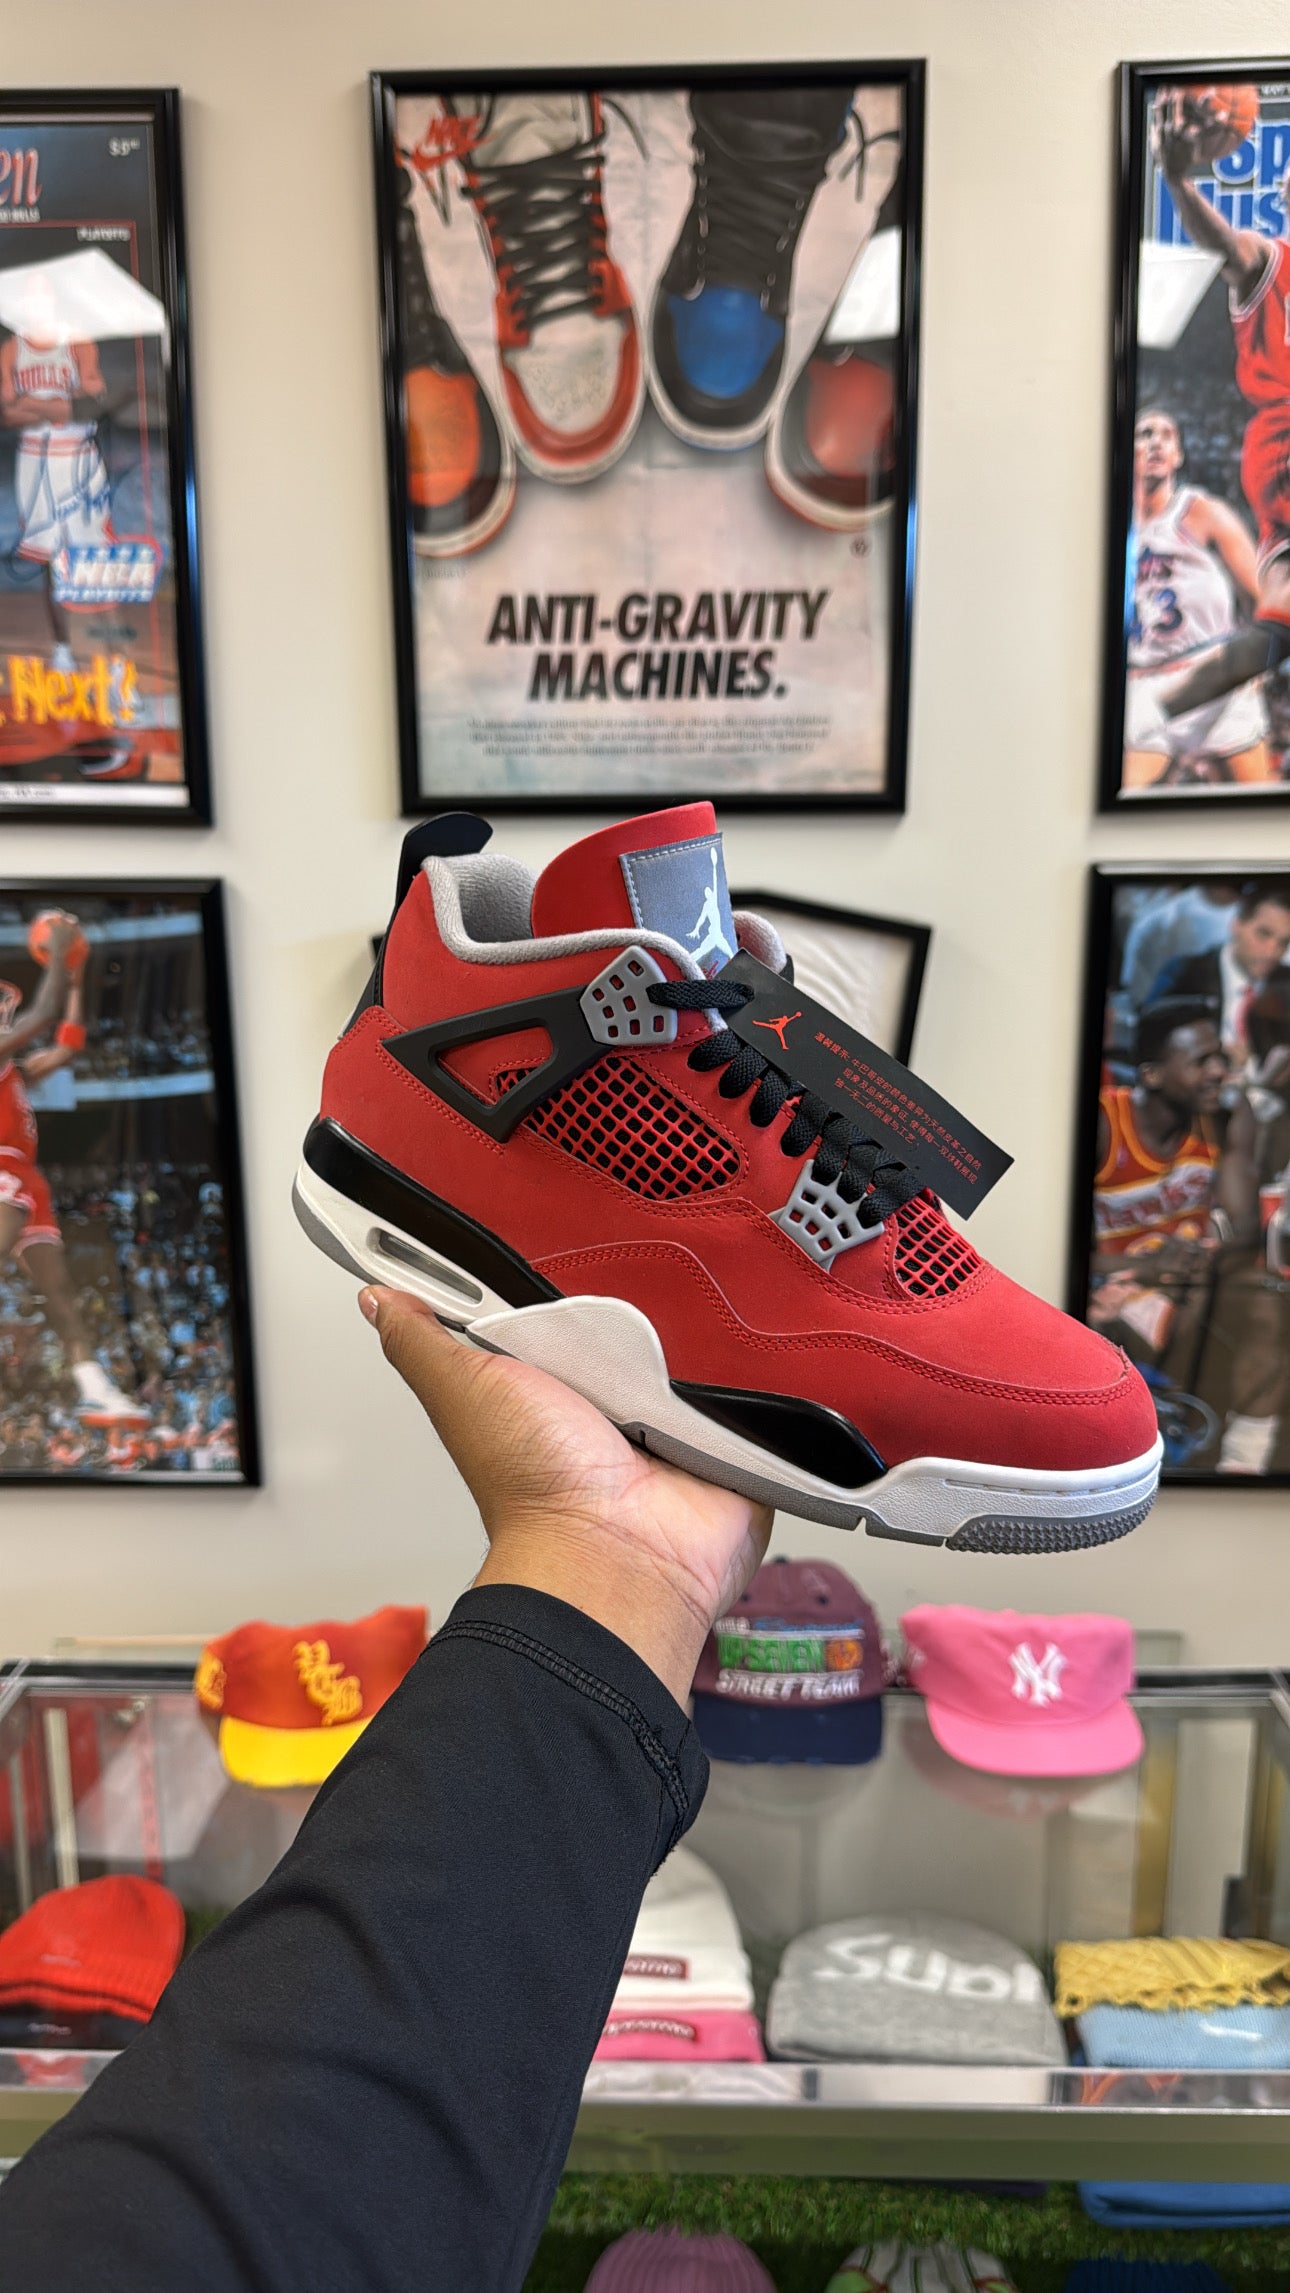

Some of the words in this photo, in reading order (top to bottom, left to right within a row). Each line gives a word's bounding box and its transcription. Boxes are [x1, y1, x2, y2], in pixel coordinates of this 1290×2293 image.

[72, 562, 156, 588] NBA
[486, 588, 833, 645] ANTI-GRAVITY
[528, 648, 790, 702] MACHINES.
[1008, 1641, 1068, 1708] NY
